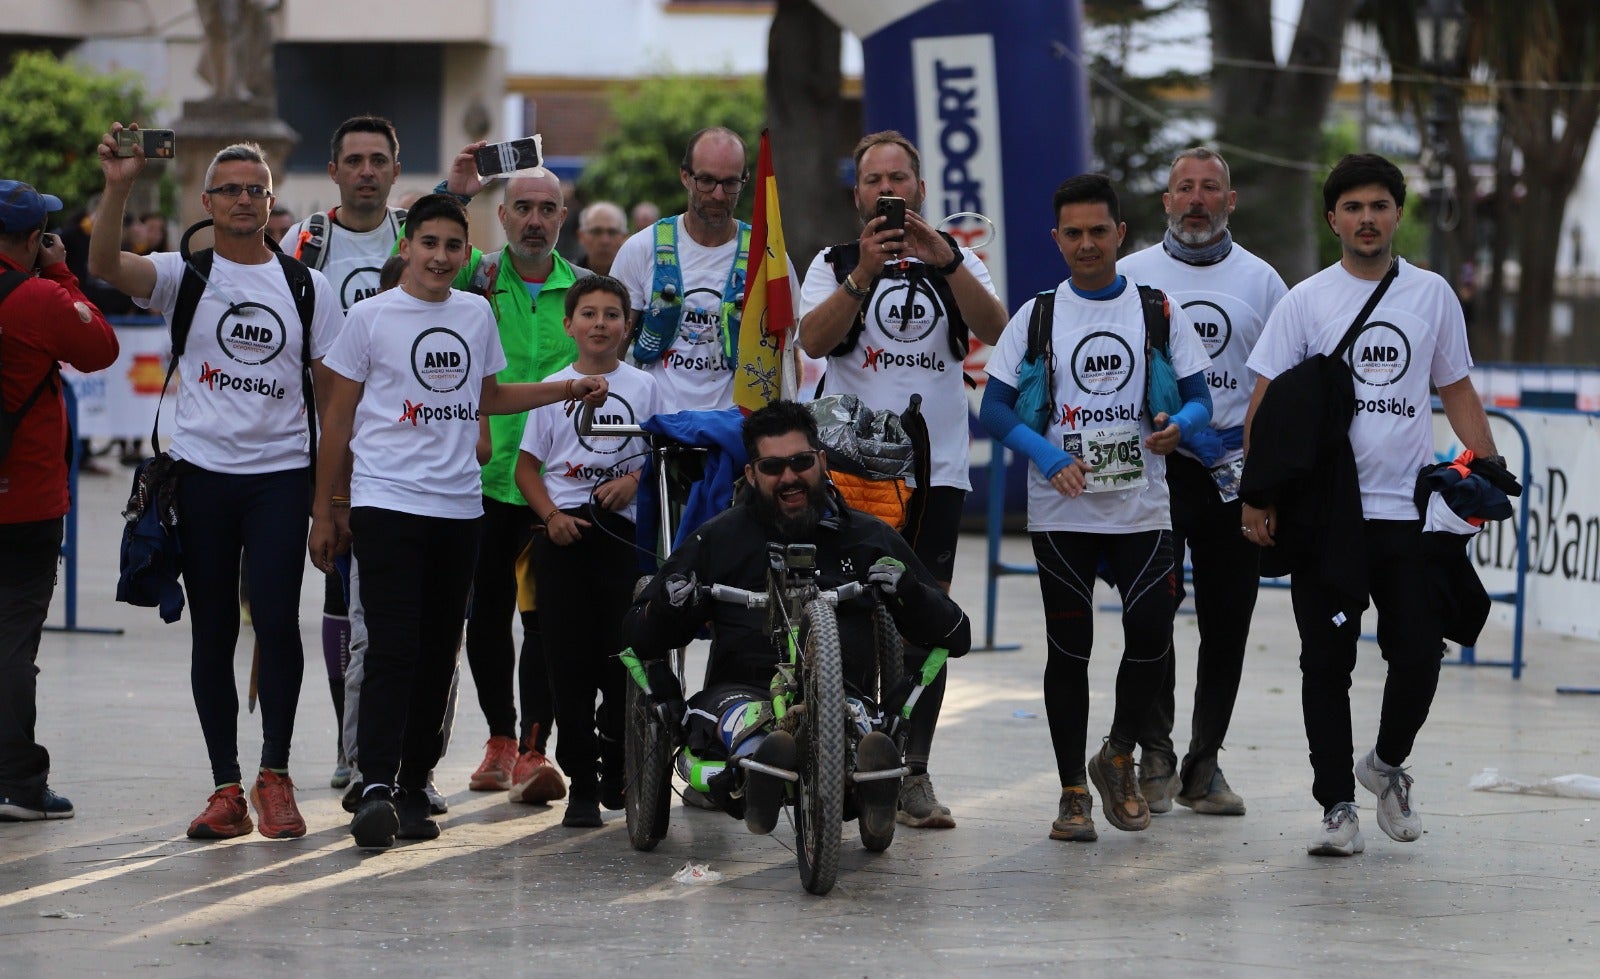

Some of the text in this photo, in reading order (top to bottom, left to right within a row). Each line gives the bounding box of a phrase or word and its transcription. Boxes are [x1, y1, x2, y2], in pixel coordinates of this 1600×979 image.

[354, 288, 379, 303] AN
[230, 322, 273, 343] AND
[1194, 322, 1219, 338] ND
[424, 352, 461, 368] AND
[1361, 346, 1399, 362] AND
[1084, 354, 1122, 372] AND
[1355, 397, 1416, 419] posible
[593, 414, 624, 426] ND
[1088, 439, 1142, 467] 3705
[1475, 465, 1600, 584] aixaBan
